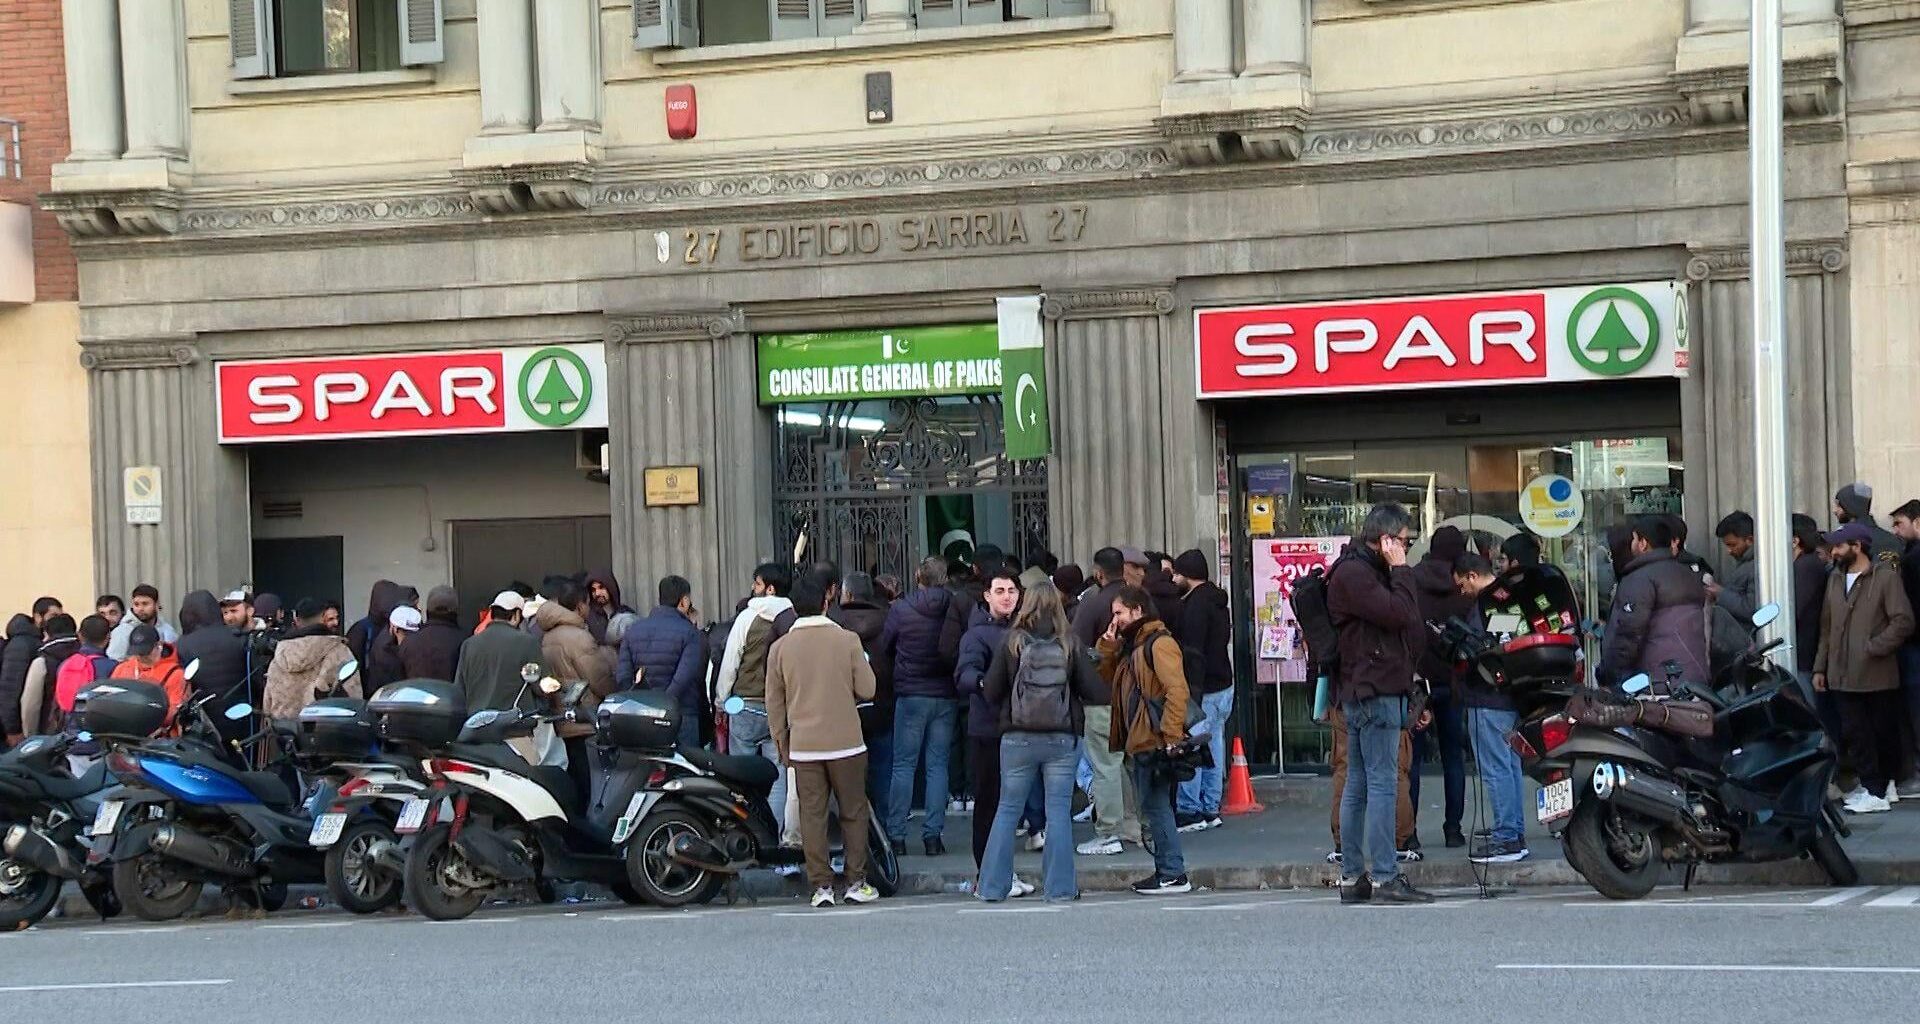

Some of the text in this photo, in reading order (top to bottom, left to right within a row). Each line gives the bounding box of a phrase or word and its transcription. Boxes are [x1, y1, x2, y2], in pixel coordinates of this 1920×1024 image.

[683, 204, 1089, 265] 27 EDIFICIO SARRIA 27
[1233, 309, 1538, 377] SPAR
[247, 366, 498, 425] SPAR
[769, 365, 859, 397] CONSULATE
[861, 362, 930, 391] GENERAL
[933, 361, 953, 388] OF
[1280, 544, 1318, 553] SPAR
[1546, 781, 1569, 799] 1004
